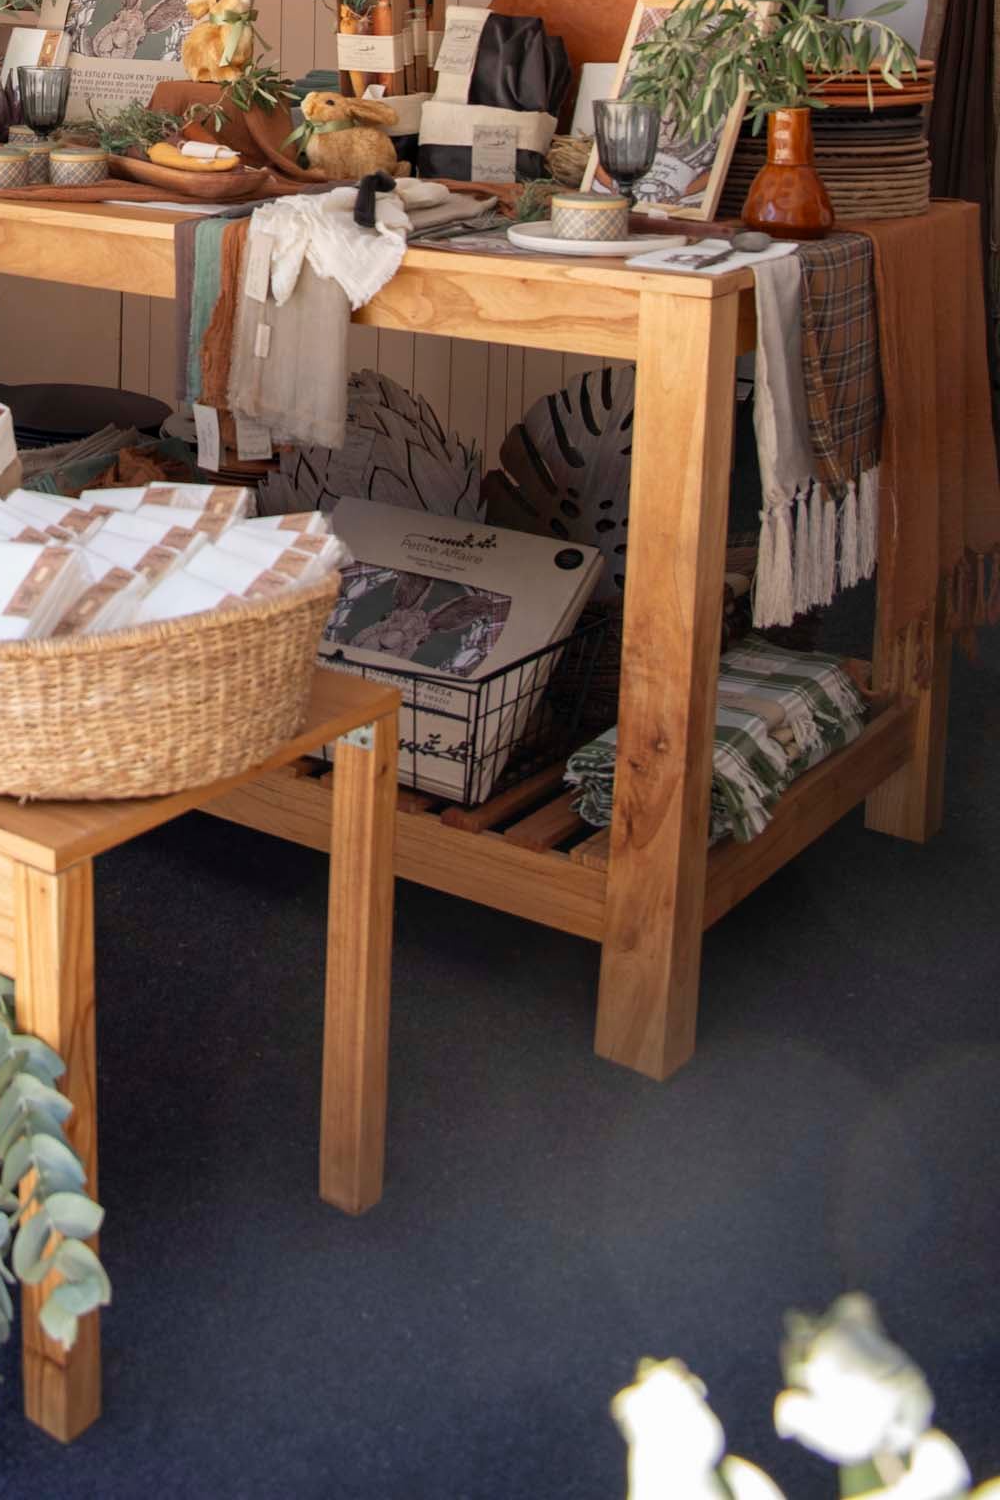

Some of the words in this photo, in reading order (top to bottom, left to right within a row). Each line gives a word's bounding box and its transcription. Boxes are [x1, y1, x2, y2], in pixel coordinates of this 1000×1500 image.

[112, 71, 134, 81] COLOR
[440, 548, 484, 565] Affaire
[427, 683, 453, 698] MESA
